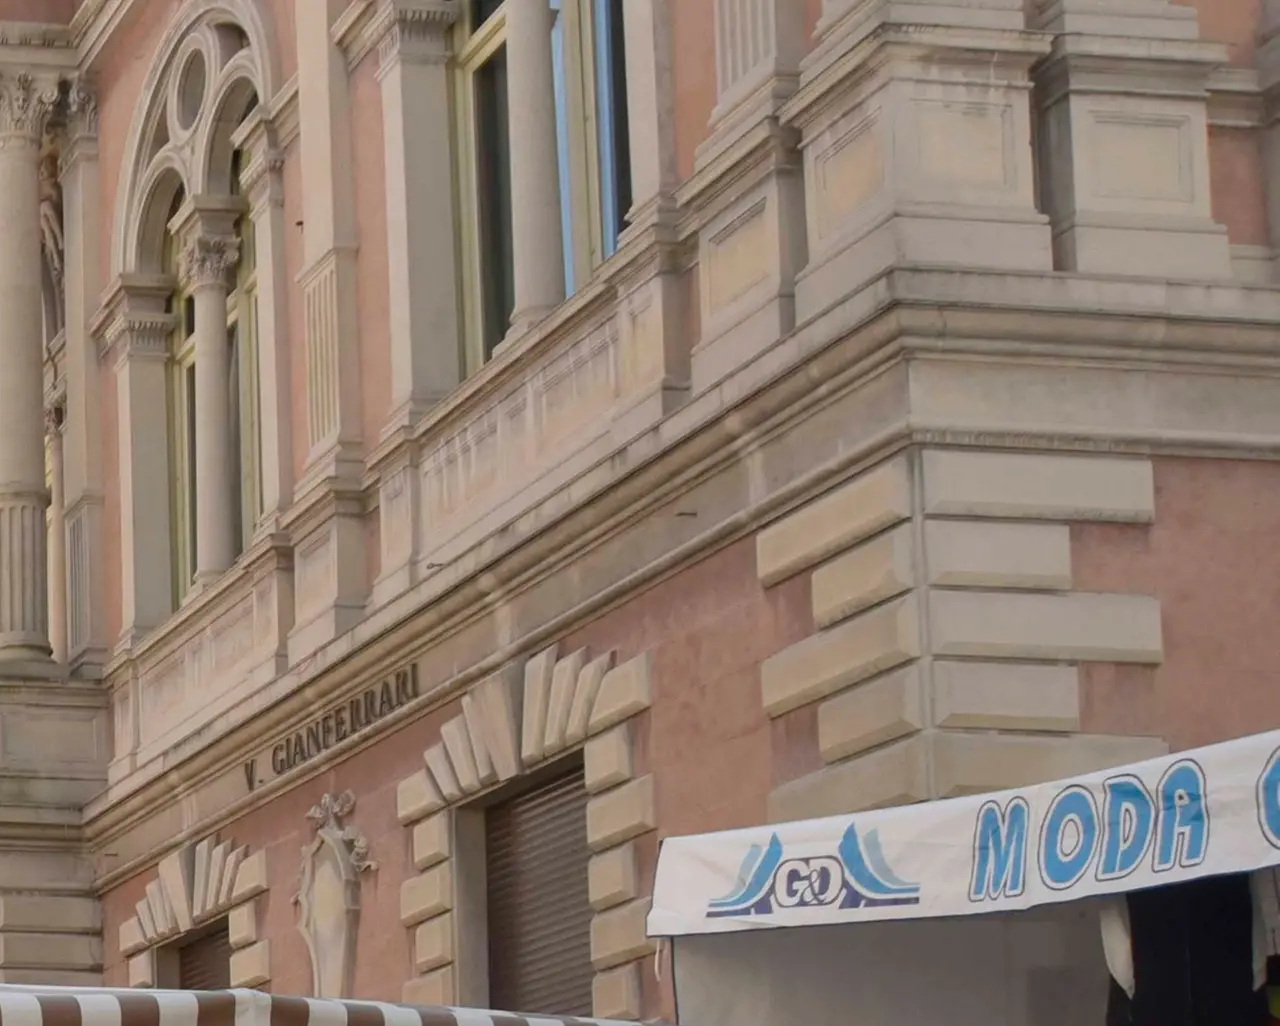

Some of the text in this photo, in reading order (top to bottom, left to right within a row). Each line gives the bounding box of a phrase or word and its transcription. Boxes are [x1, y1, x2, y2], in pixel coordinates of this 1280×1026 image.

[244, 662, 420, 791] V. GIANFERRARI
[773, 855, 843, 908] G&D
[969, 758, 1210, 901] MODA
